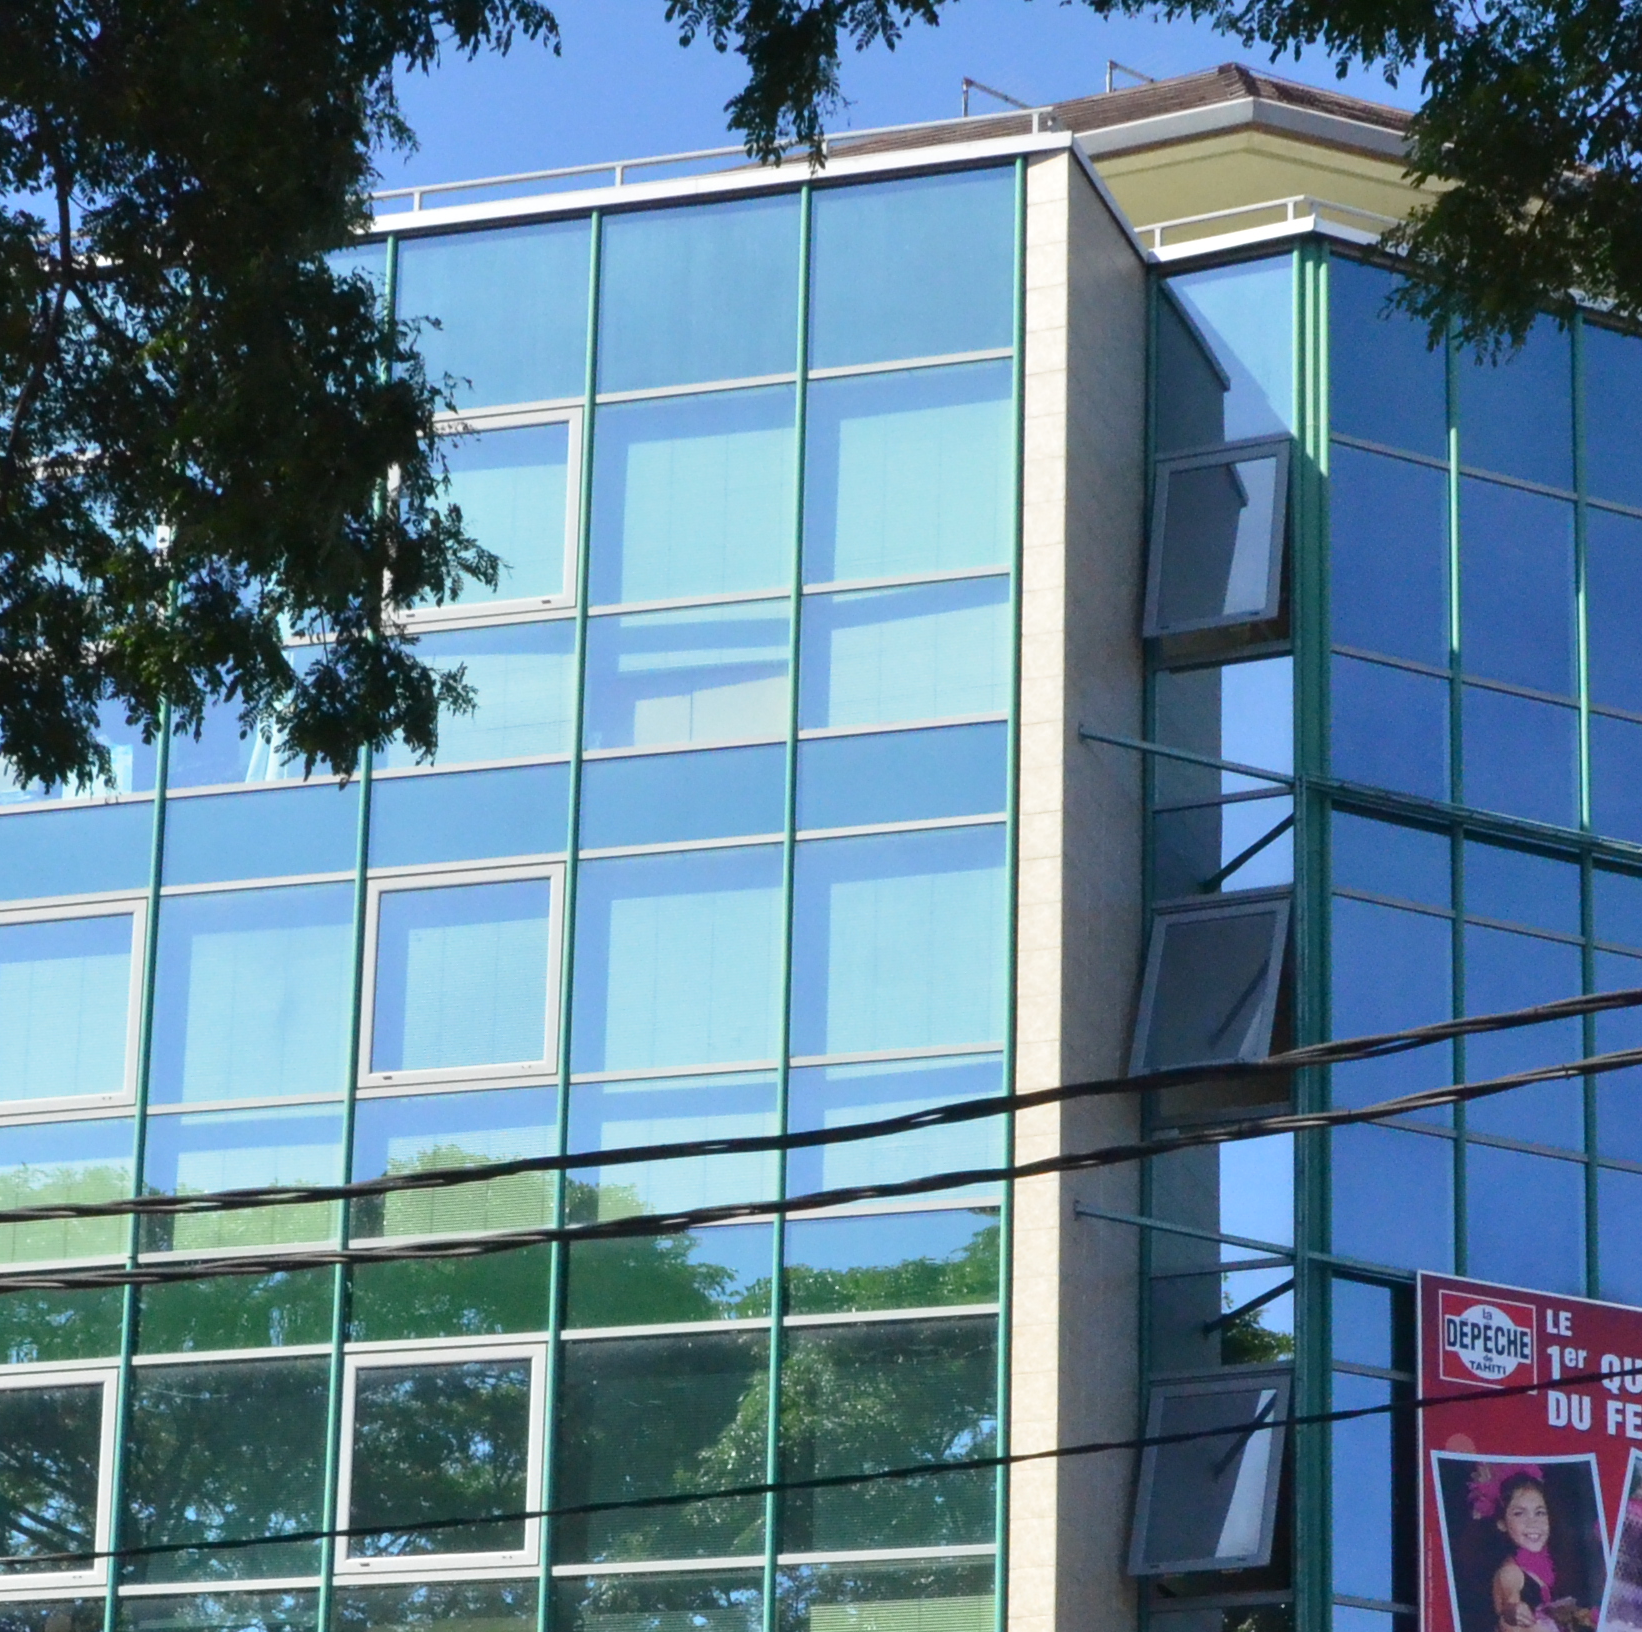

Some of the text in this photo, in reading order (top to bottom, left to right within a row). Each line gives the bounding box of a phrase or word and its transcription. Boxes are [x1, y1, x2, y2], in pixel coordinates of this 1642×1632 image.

[1483, 1308, 1493, 1320] la
[1546, 1309, 1572, 1336] LE
[1469, 1360, 1506, 1375] TAHITI
[1547, 1346, 1587, 1381] 1er
[1548, 1391, 1591, 1431] DU
